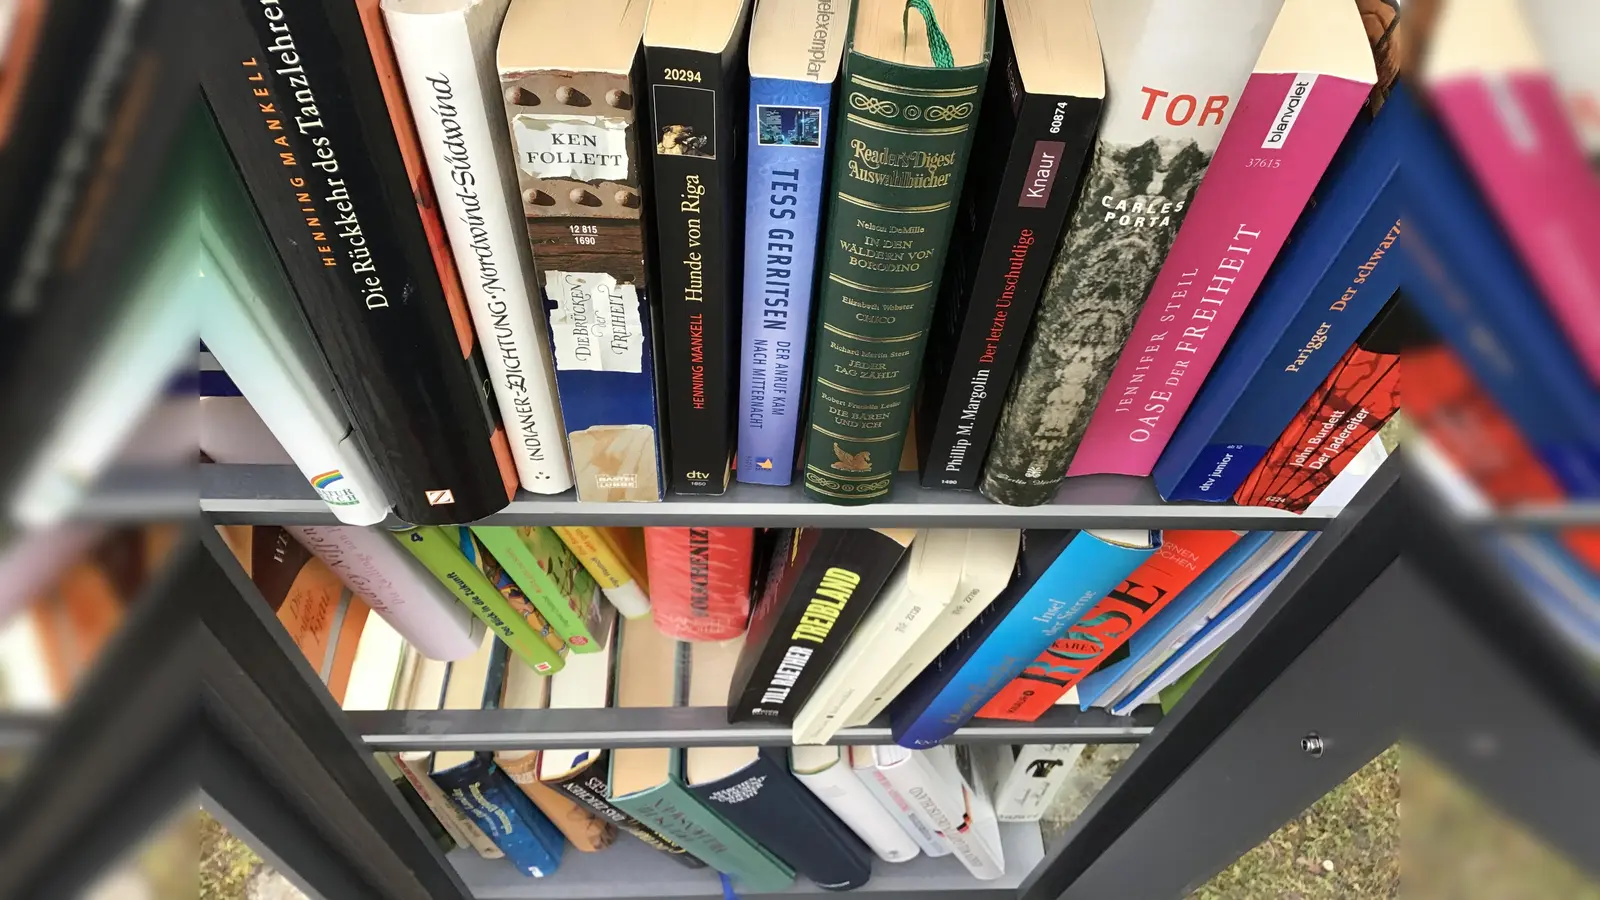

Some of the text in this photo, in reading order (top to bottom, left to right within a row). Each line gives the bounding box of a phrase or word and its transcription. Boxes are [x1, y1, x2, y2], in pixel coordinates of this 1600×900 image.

[664, 69, 701, 82] 20294
[1050, 101, 1068, 134] 60874
[1140, 86, 1229, 127] TOR
[1268, 81, 1309, 143] blanvalet
[312, 136, 338, 172] des
[552, 133, 597, 147] KEN
[243, 57, 337, 266] HENNING MANKELL
[527, 152, 621, 166] FOLLETT
[849, 160, 951, 188] Auswahlbücher
[910, 149, 955, 173] Digest
[1026, 152, 1055, 198] Knaur
[1246, 158, 1281, 168] 37615
[1101, 195, 1186, 214] CARLES
[1104, 212, 1170, 227] PORTA
[326, 178, 376, 273] Rückkehr
[570, 225, 598, 234] 12 815
[575, 236, 595, 245] 1690
[681, 174, 705, 302] Hunde von Riga
[763, 169, 799, 330] TESS GERRITSEN
[840, 240, 934, 261] WÄLDERN VON
[864, 236, 913, 249] IN DEN
[849, 257, 920, 272] BORODINO
[360, 277, 389, 310] Die
[979, 228, 1035, 363] Der letzte Unschuldige
[609, 293, 632, 355] FREIHEIT
[856, 313, 896, 324] CHICO
[1129, 224, 1262, 443] OASE DER FREIHEIT
[1285, 322, 1332, 372] Parigger
[1329, 287, 1357, 312] Der
[830, 341, 859, 356] Richard
[1116, 268, 1198, 413] JENNIFER STEIL
[690, 313, 705, 409] HENNING MANKELL
[834, 364, 857, 377] TAG
[849, 360, 887, 370] JEDER
[750, 339, 768, 429] NACH MITTERNACHT
[772, 341, 791, 416] DER ANRUF KAM
[829, 407, 848, 418] DIE
[835, 417, 883, 429] UND ICH
[946, 369, 990, 472] Phillip M. Margolin
[1290, 409, 1345, 467] John Burdett
[1309, 408, 1370, 470] Der Jadereiter
[686, 470, 710, 479] dtv
[1199, 453, 1234, 492] dtv junior
[1160, 540, 1199, 562] RNEN
[447, 571, 514, 637] Der Blick in die Zukunft
[791, 567, 861, 643] TREIBLAND
[1033, 598, 1066, 623] Insel
[1017, 580, 1168, 688] ROSE
[1052, 642, 1097, 653] KAREN
[770, 646, 814, 688] RAETHER
[761, 687, 791, 704] TILL
